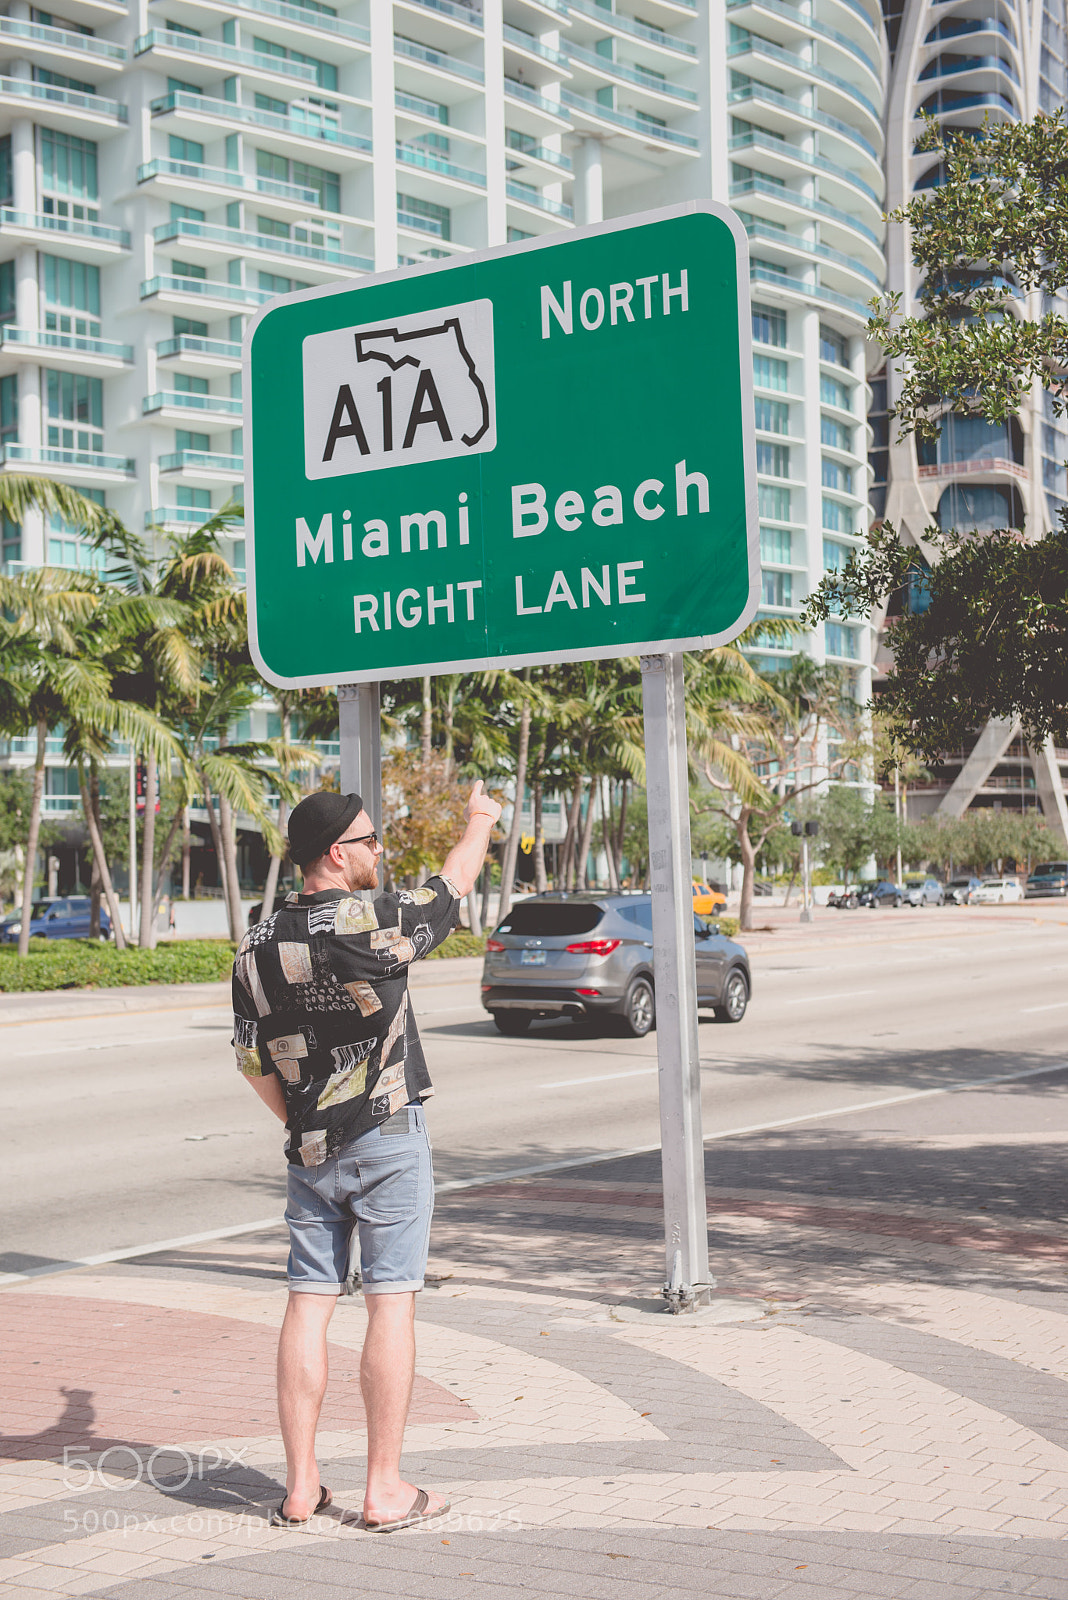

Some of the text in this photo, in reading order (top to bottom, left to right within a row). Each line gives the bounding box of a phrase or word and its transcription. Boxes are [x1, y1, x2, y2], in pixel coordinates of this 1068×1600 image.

[541, 269, 689, 340] NORTH
[322, 369, 454, 463] A1A
[296, 459, 710, 568] Miami Beach
[354, 561, 646, 634] RIGHT LANE
